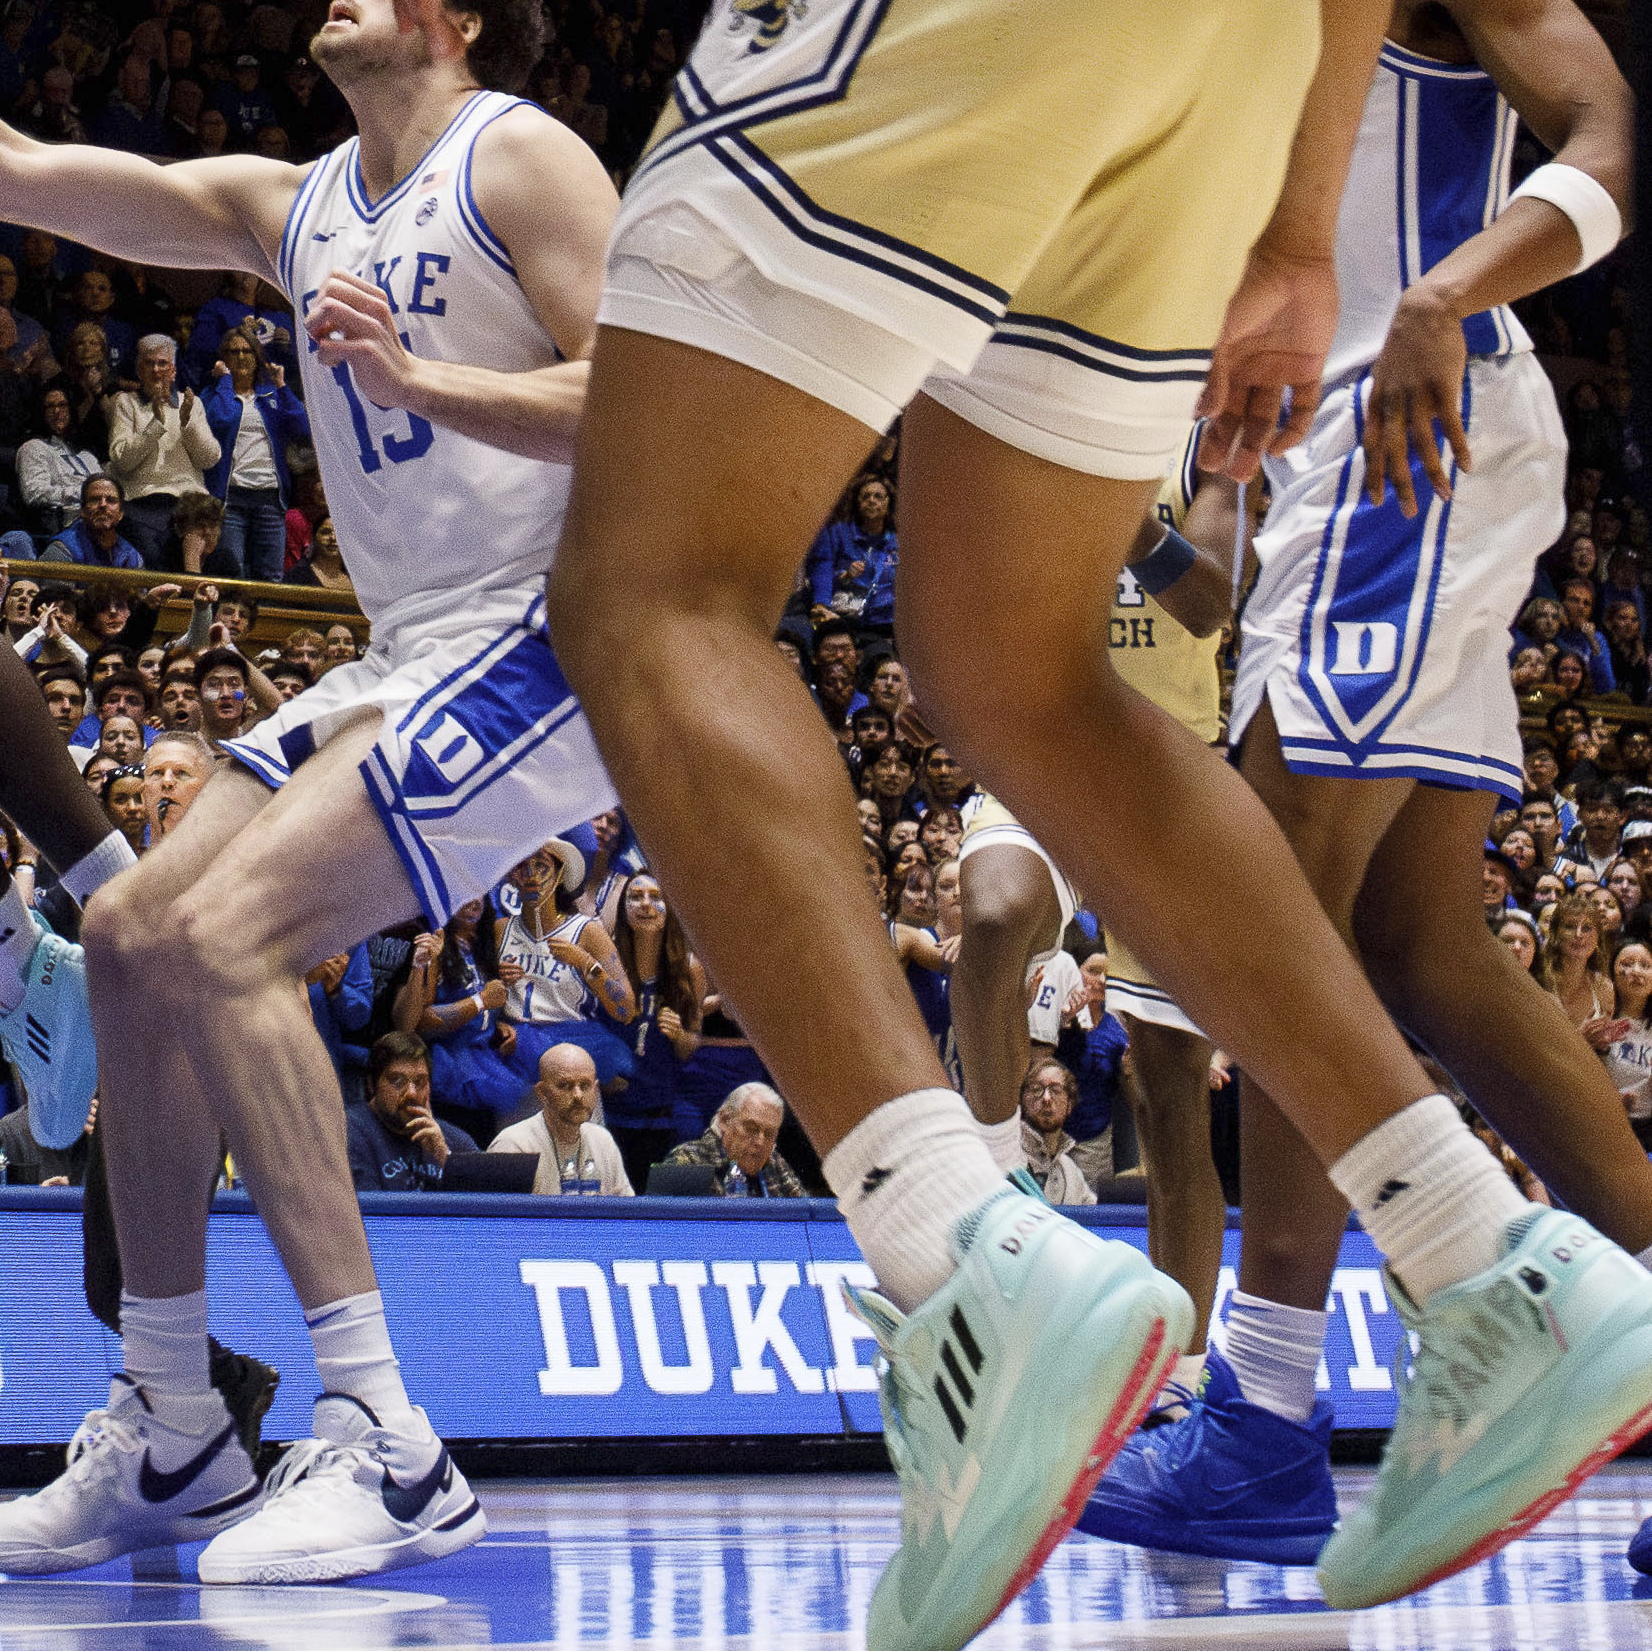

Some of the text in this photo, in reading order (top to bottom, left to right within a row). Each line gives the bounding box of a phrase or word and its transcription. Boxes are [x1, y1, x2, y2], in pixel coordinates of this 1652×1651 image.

[1329, 621, 1398, 674] D
[413, 710, 485, 785] D
[522, 982, 535, 1018] 1
[519, 1260, 879, 1396] DUKE
